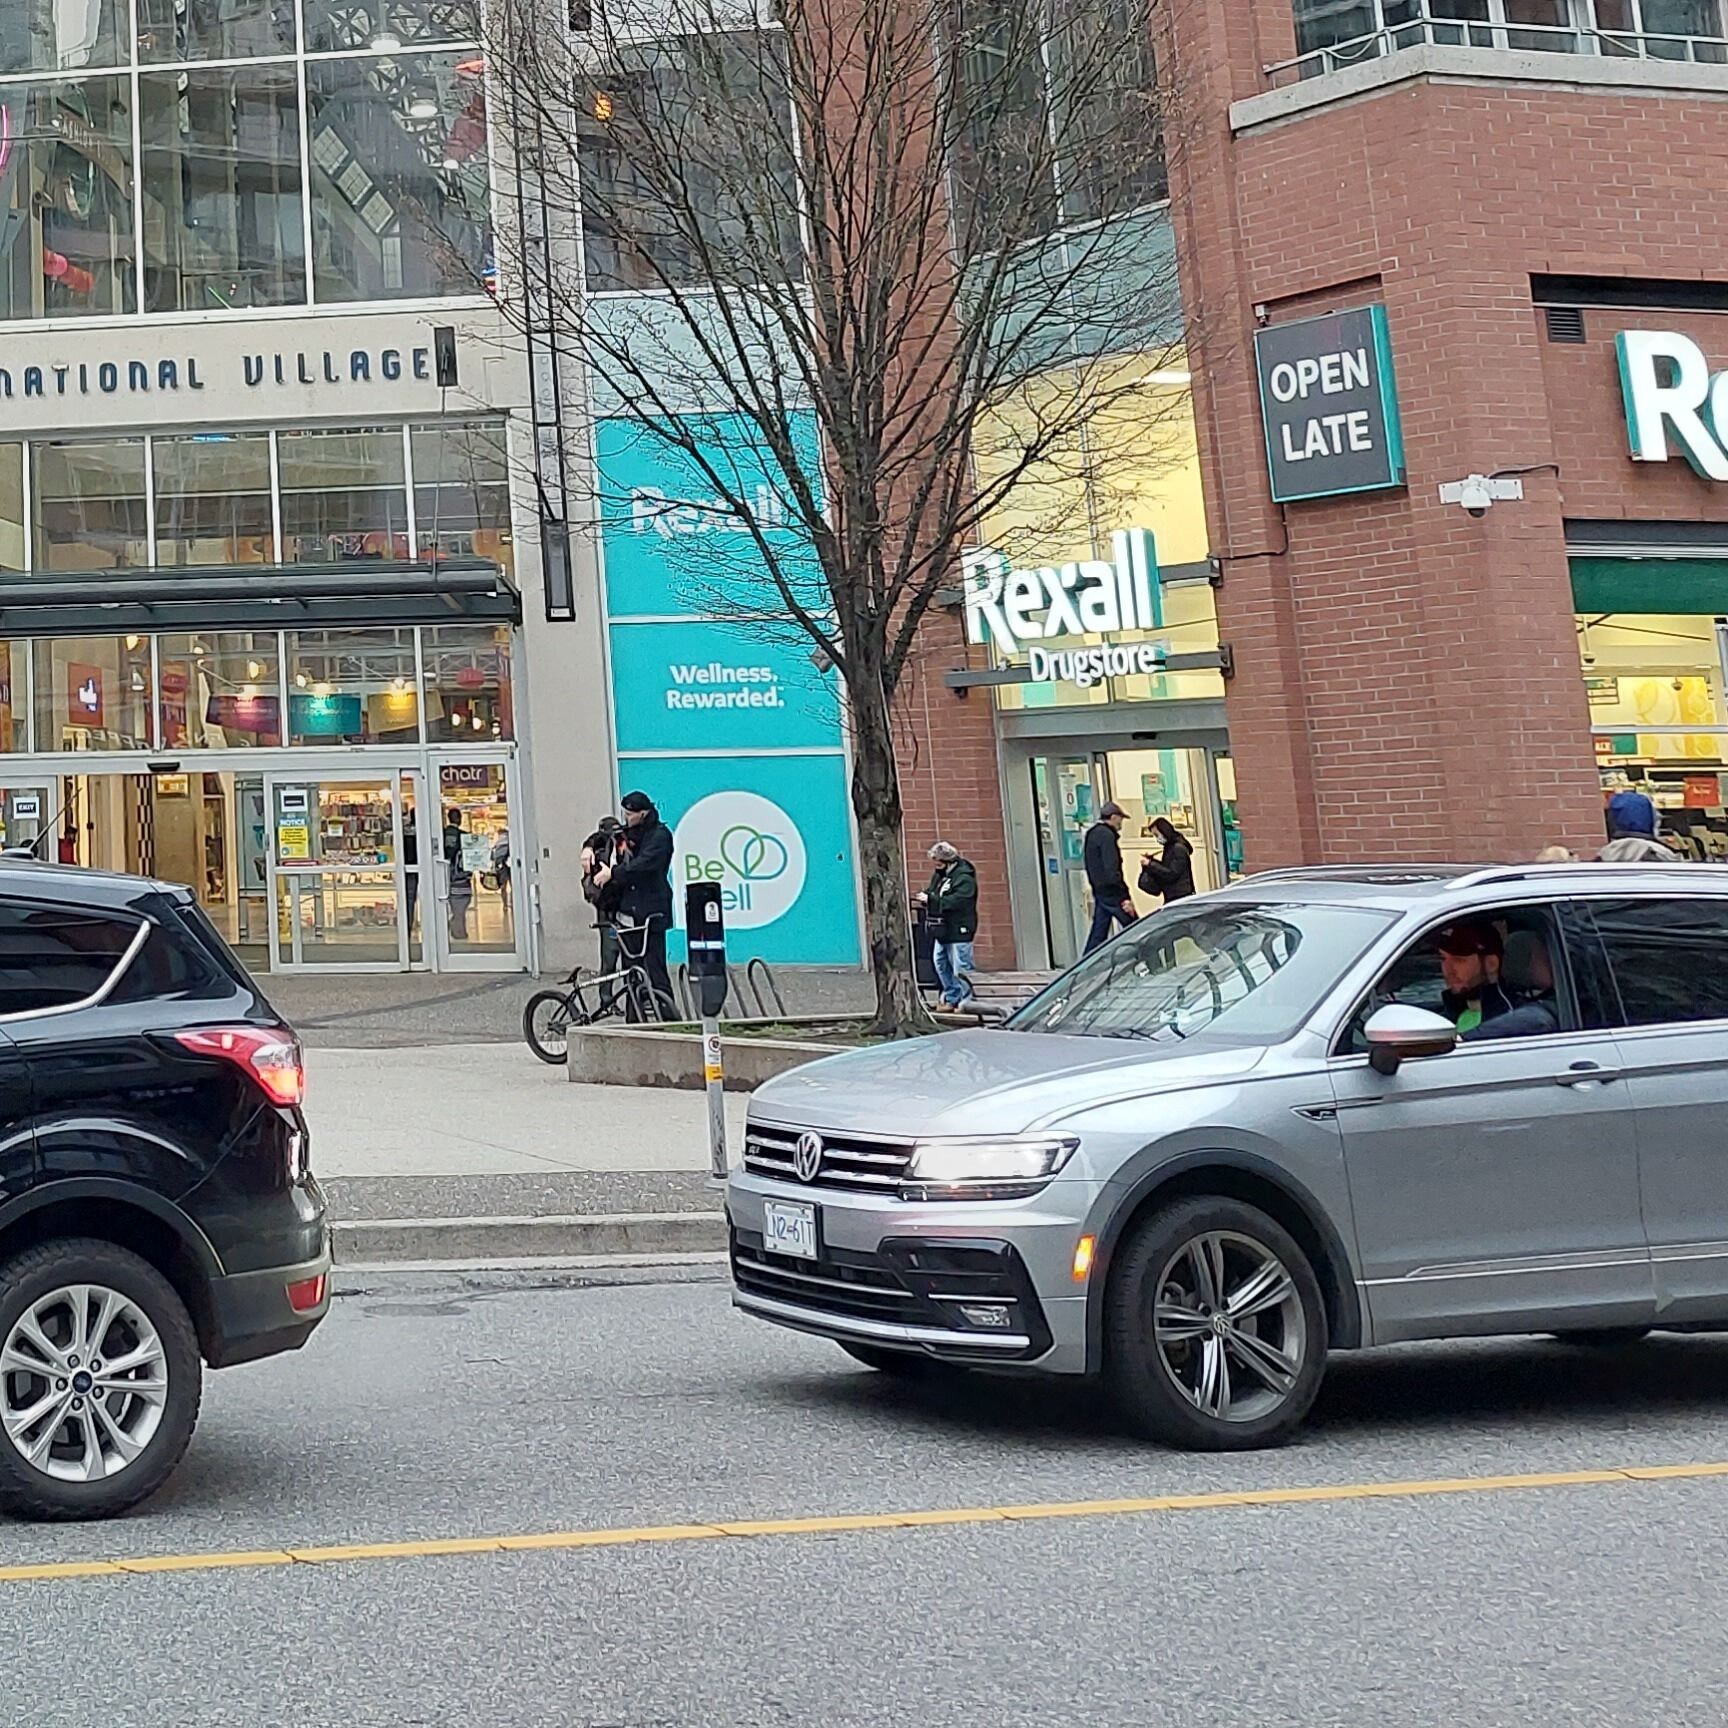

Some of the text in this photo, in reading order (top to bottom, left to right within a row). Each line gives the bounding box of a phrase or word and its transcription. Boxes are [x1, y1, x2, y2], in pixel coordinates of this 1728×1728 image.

[242, 346, 430, 387] VILLAGE
[1270, 348, 1370, 404] OPEN
[1617, 328, 1728, 481] R
[1280, 410, 1373, 463] LATE
[961, 528, 1160, 654] Rexall
[670, 663, 779, 685] Wellness.
[1029, 642, 1158, 689] Drugstore
[441, 766, 483, 783] chatr
[684, 854, 726, 881] Be
[721, 883, 752, 912] ell
